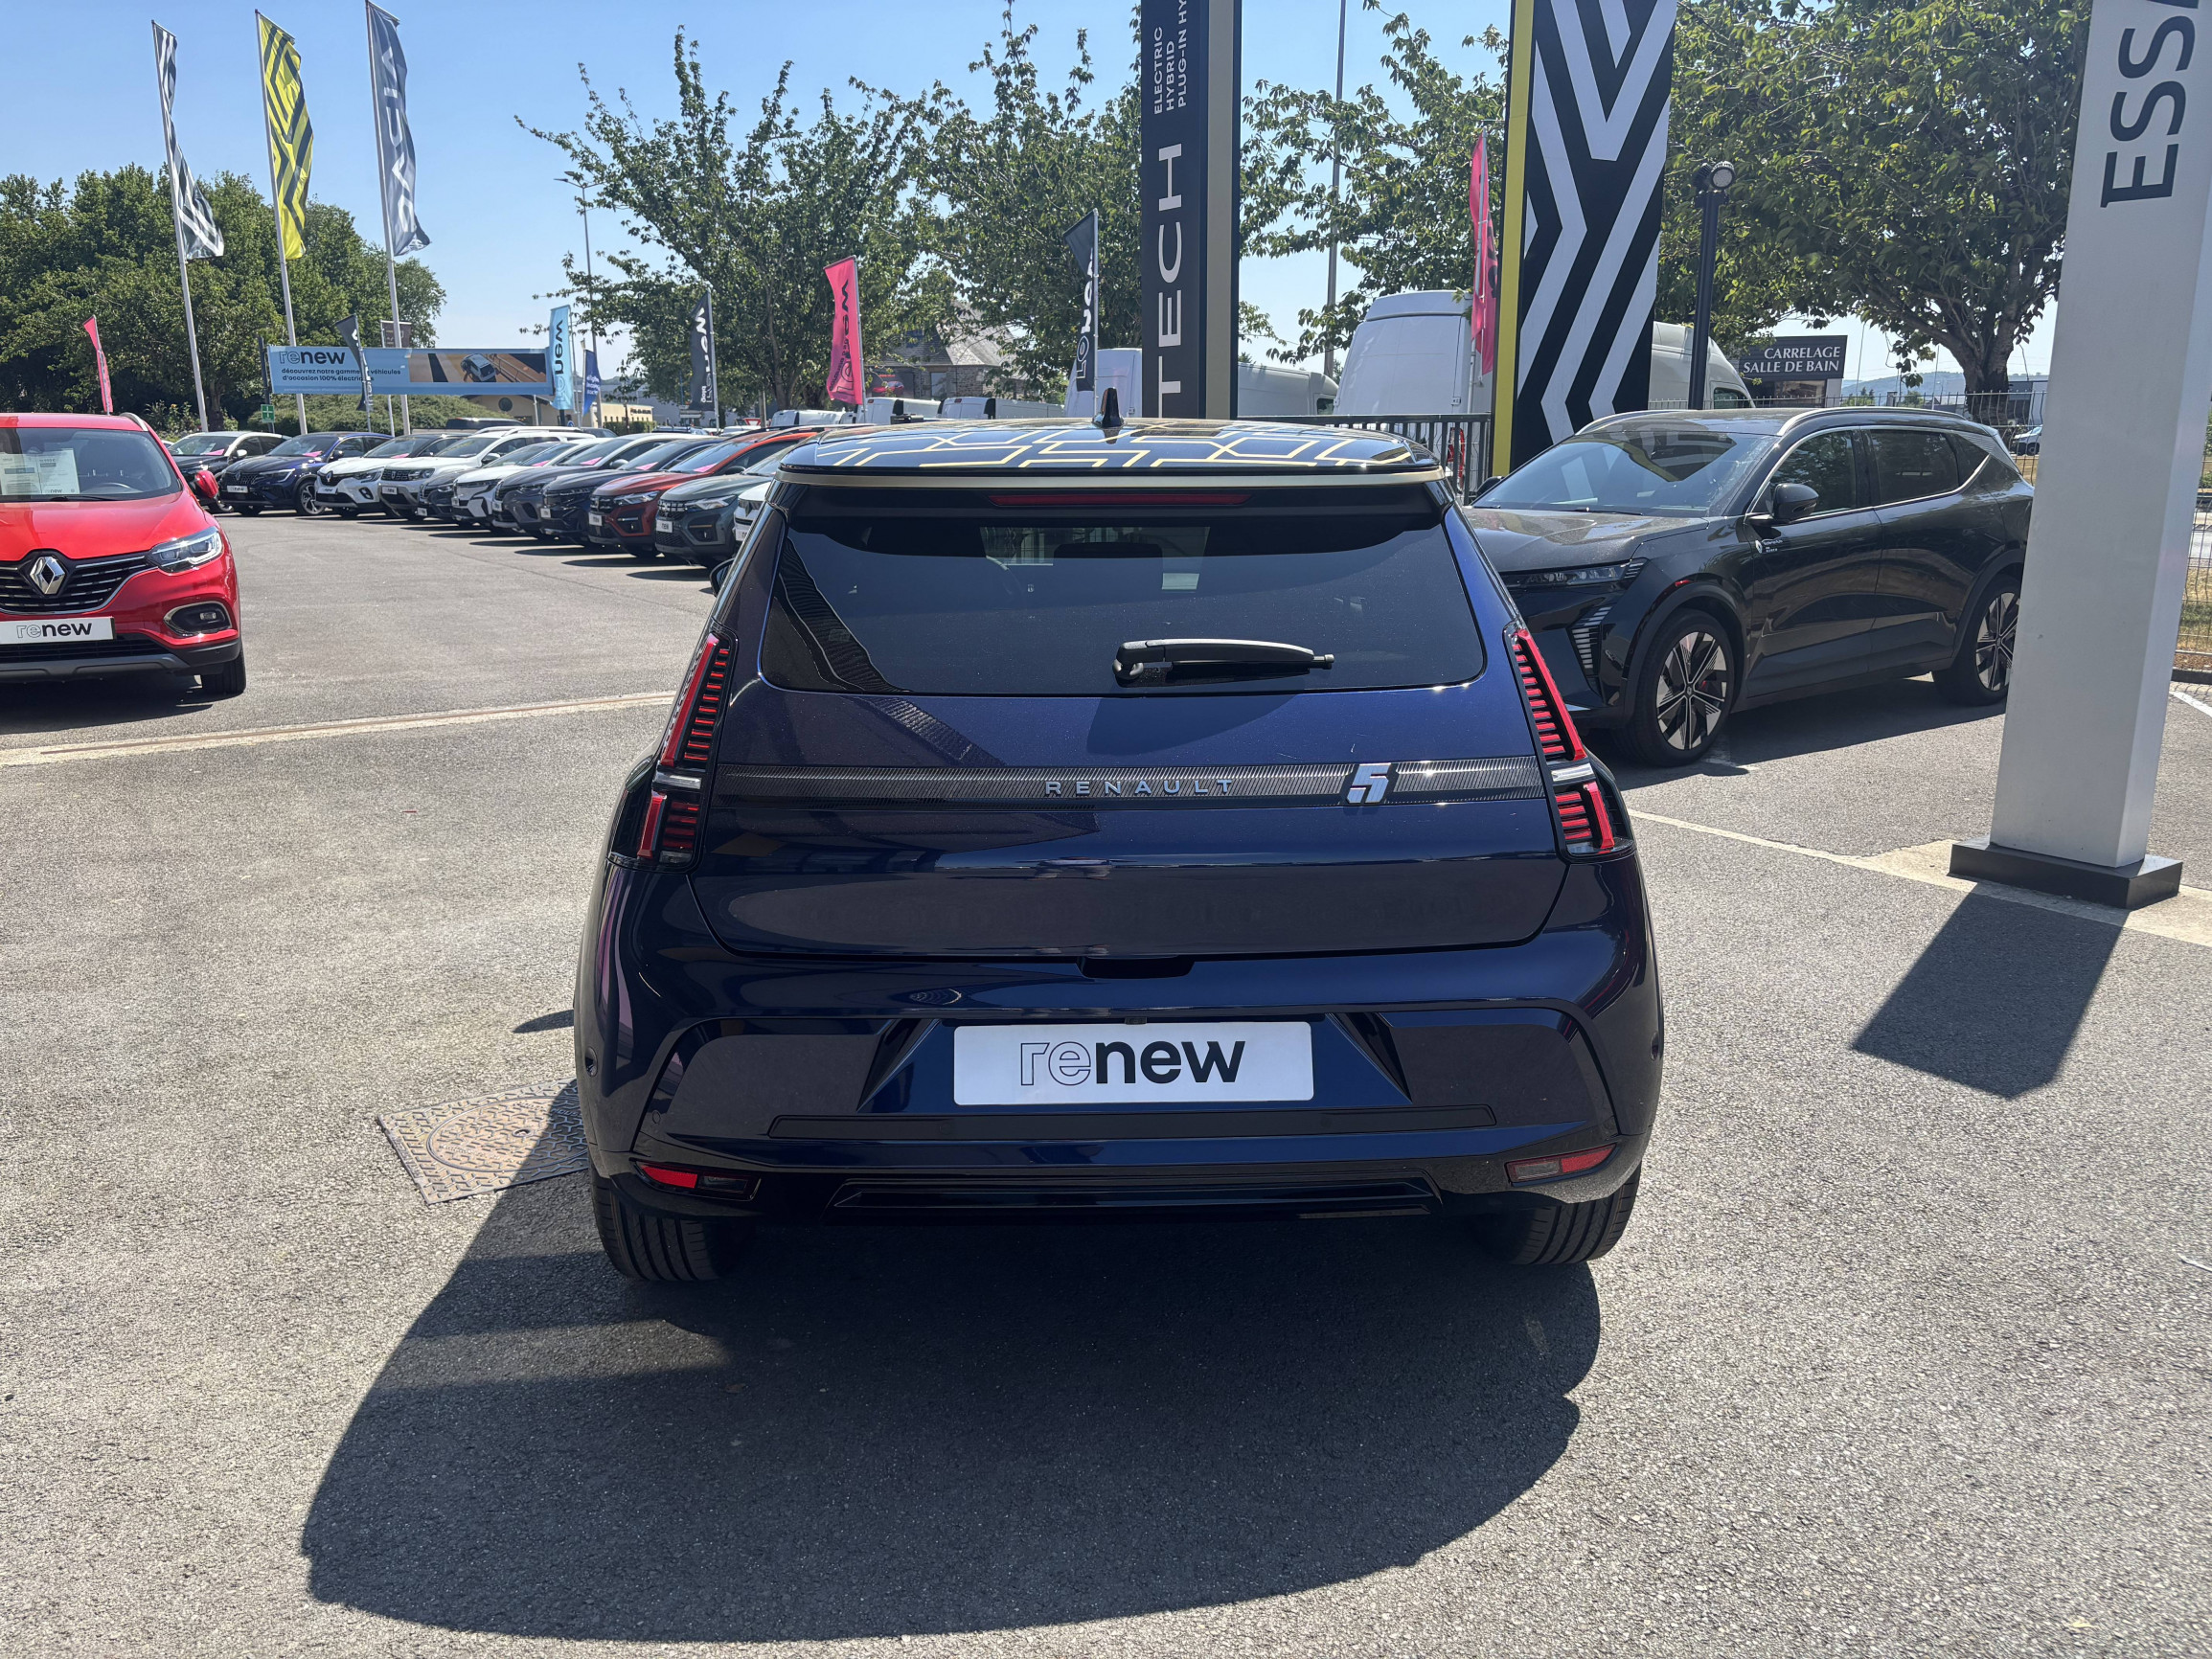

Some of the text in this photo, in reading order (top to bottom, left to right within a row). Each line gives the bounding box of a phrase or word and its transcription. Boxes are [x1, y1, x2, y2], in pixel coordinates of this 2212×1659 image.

[1153, 27, 1163, 115] ELECTRIC
[1166, 40, 1174, 111] HYBRID
[1177, 29, 1187, 108] PLUG-IN
[2100, 0, 2199, 208] ESS
[1158, 144, 1181, 418] TECH
[279, 351, 346, 365] renew
[1744, 360, 1839, 374] SALLE DE BAIN
[1764, 346, 1840, 359] CARRELAGE
[16, 623, 93, 639] renew
[1045, 761, 1392, 805] RENAULT 5
[1020, 1040, 1246, 1086] renew
